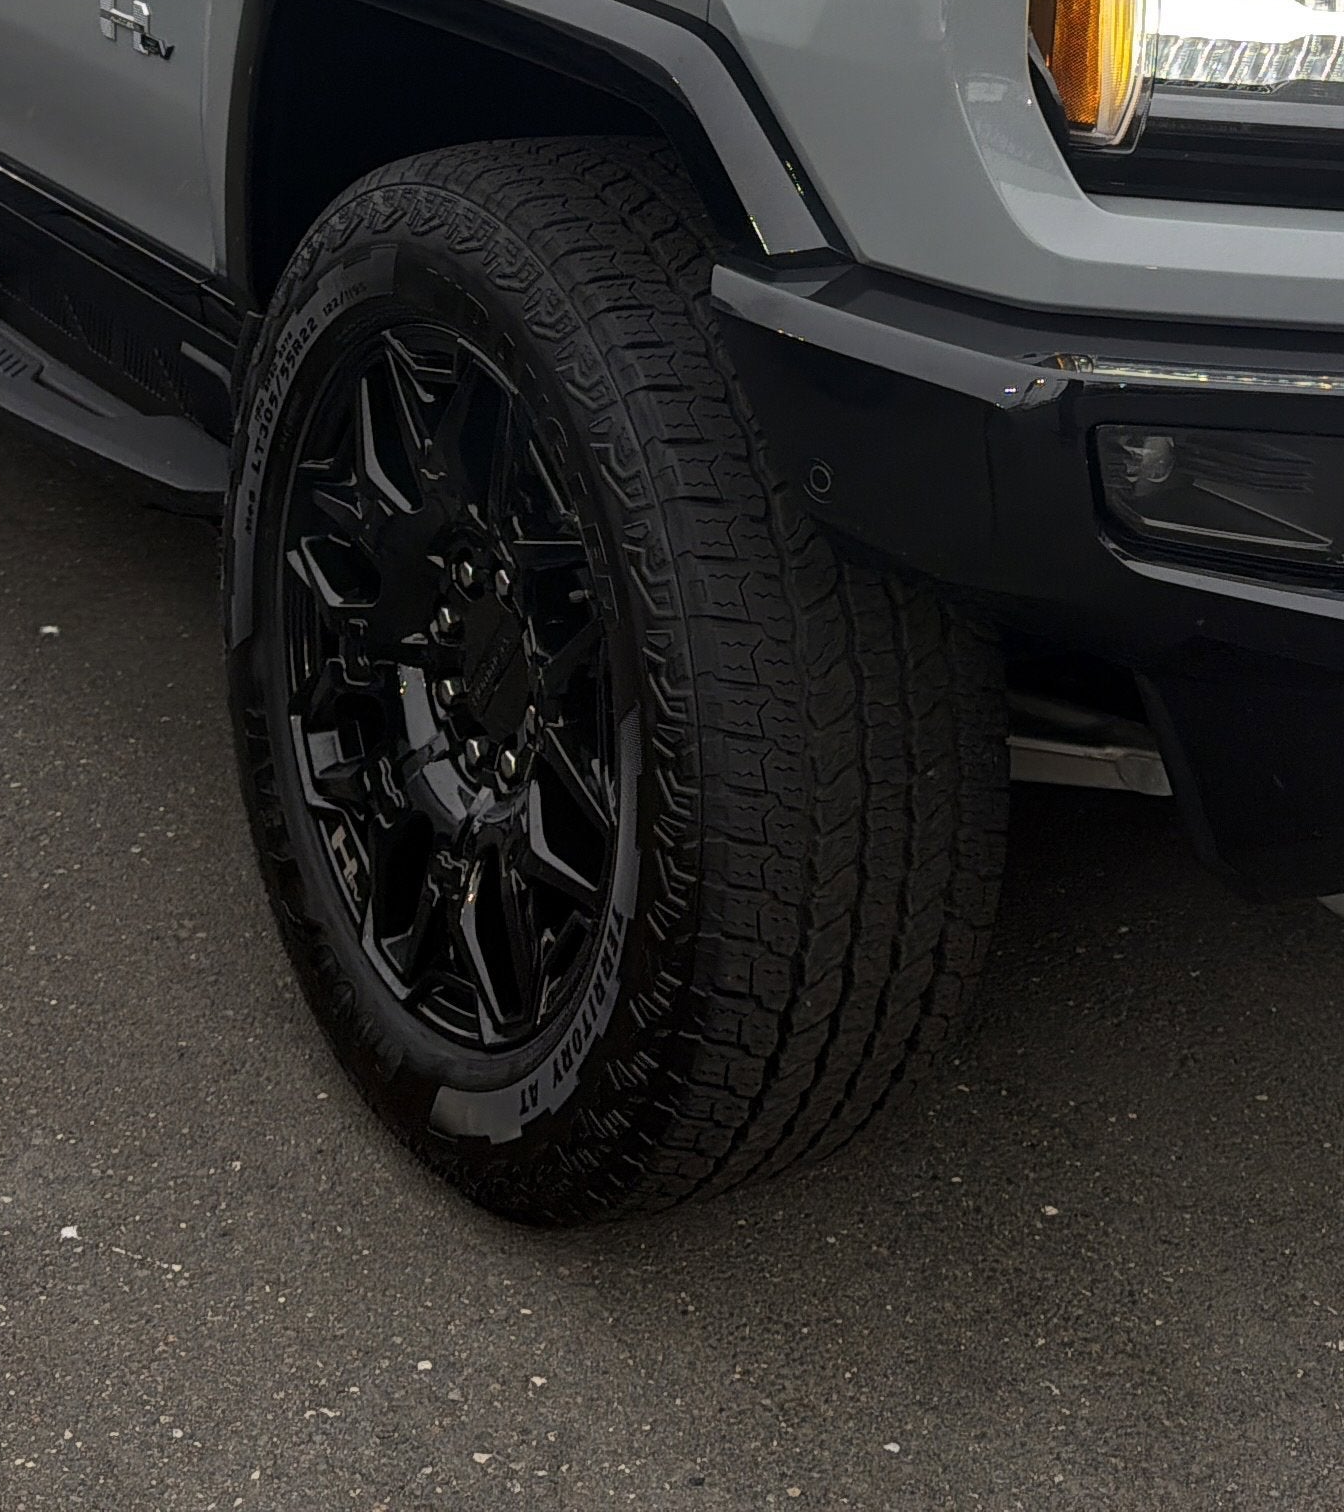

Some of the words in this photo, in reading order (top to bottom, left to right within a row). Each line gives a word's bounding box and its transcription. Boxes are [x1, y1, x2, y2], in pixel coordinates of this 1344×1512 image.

[251, 316, 318, 476] LT305/55R22
[552, 903, 624, 1089] TERRITORY
[518, 1078, 540, 1117] AT
